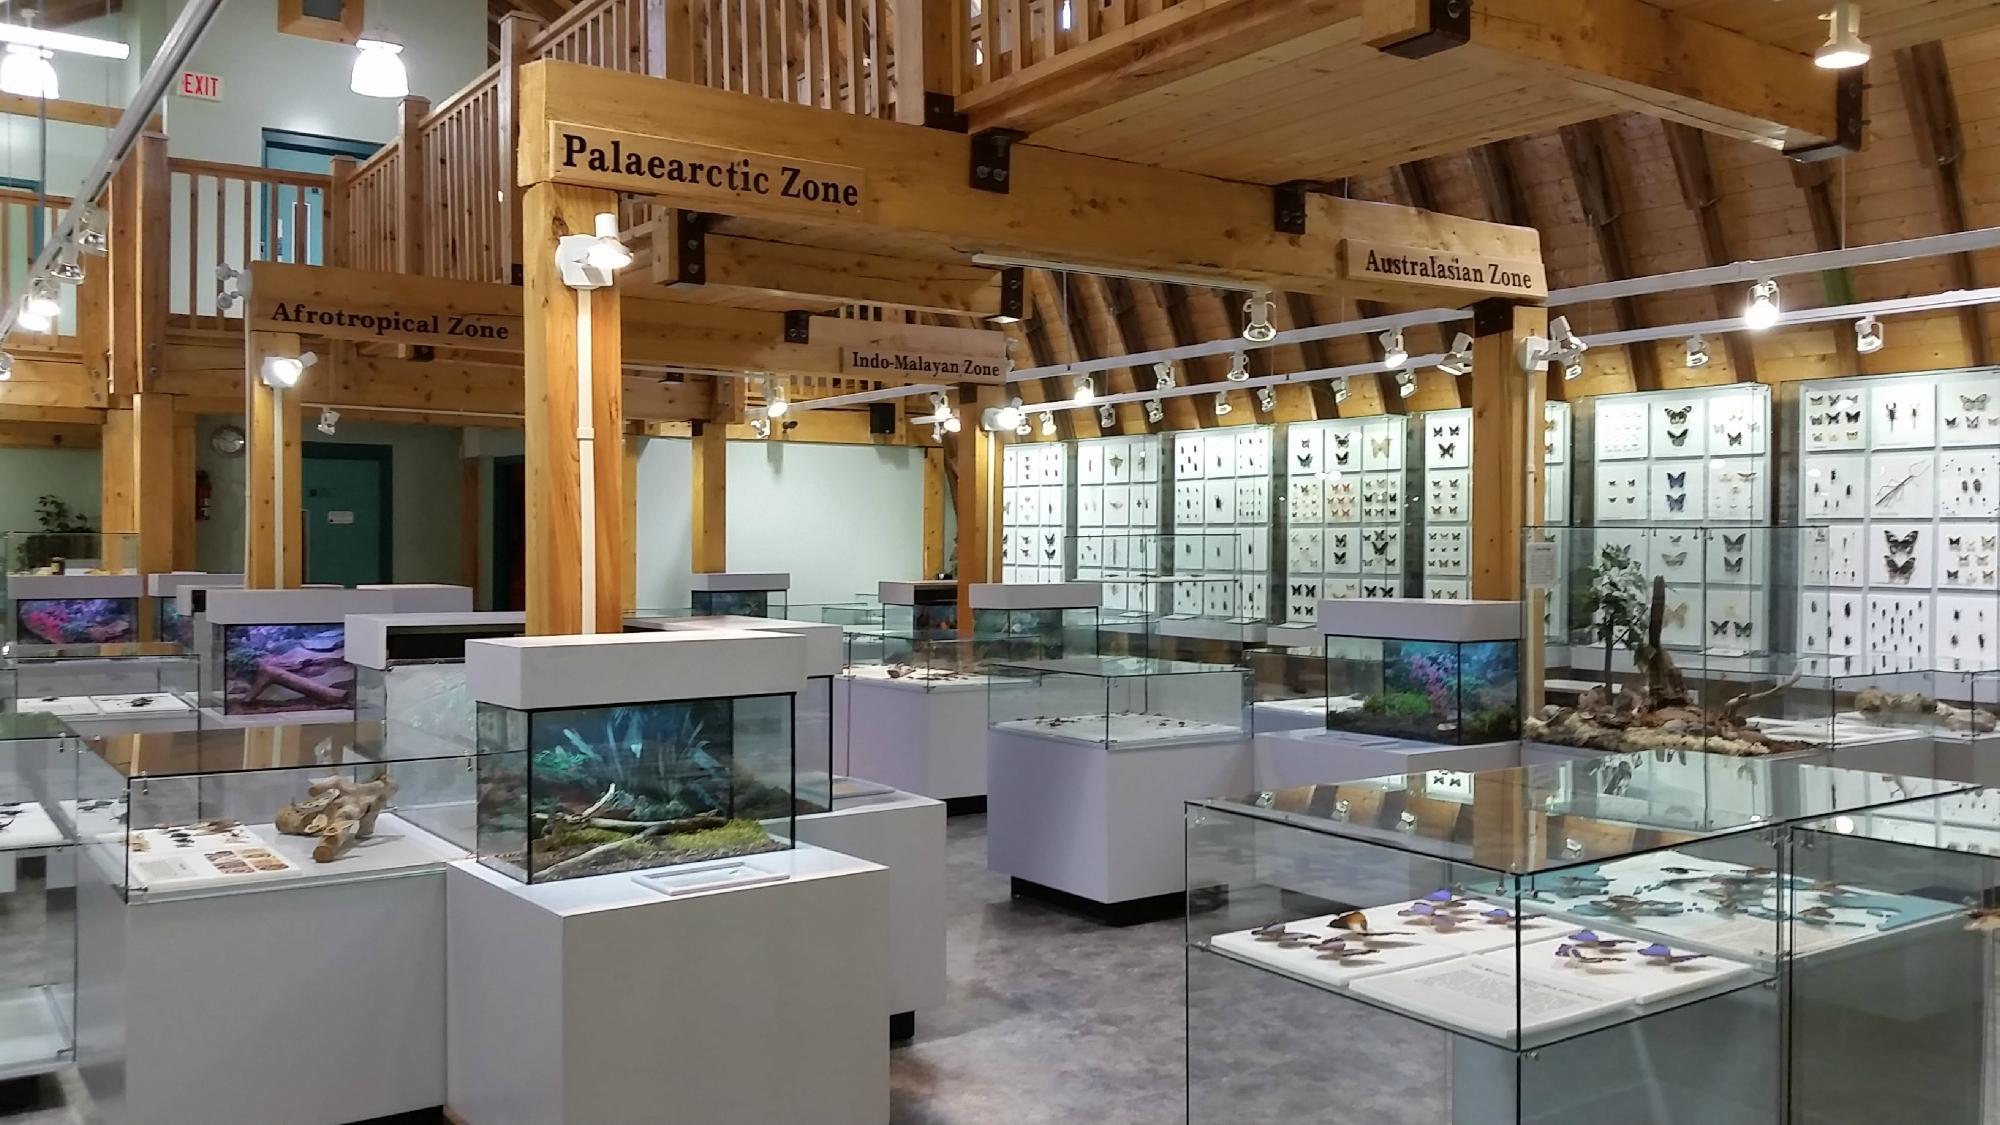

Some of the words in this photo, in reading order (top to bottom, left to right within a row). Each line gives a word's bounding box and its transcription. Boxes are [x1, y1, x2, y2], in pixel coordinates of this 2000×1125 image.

[184, 73, 219, 96] EXIT
[562, 134, 769, 194] Palaearctic
[780, 166, 858, 206] Zone
[1365, 250, 1485, 283] Australasian
[1488, 263, 1532, 289] Zone
[271, 302, 440, 336] Afrotropical
[447, 316, 509, 339] Zone
[852, 351, 959, 377] Indo-Malayan
[963, 359, 1000, 376] Zone
